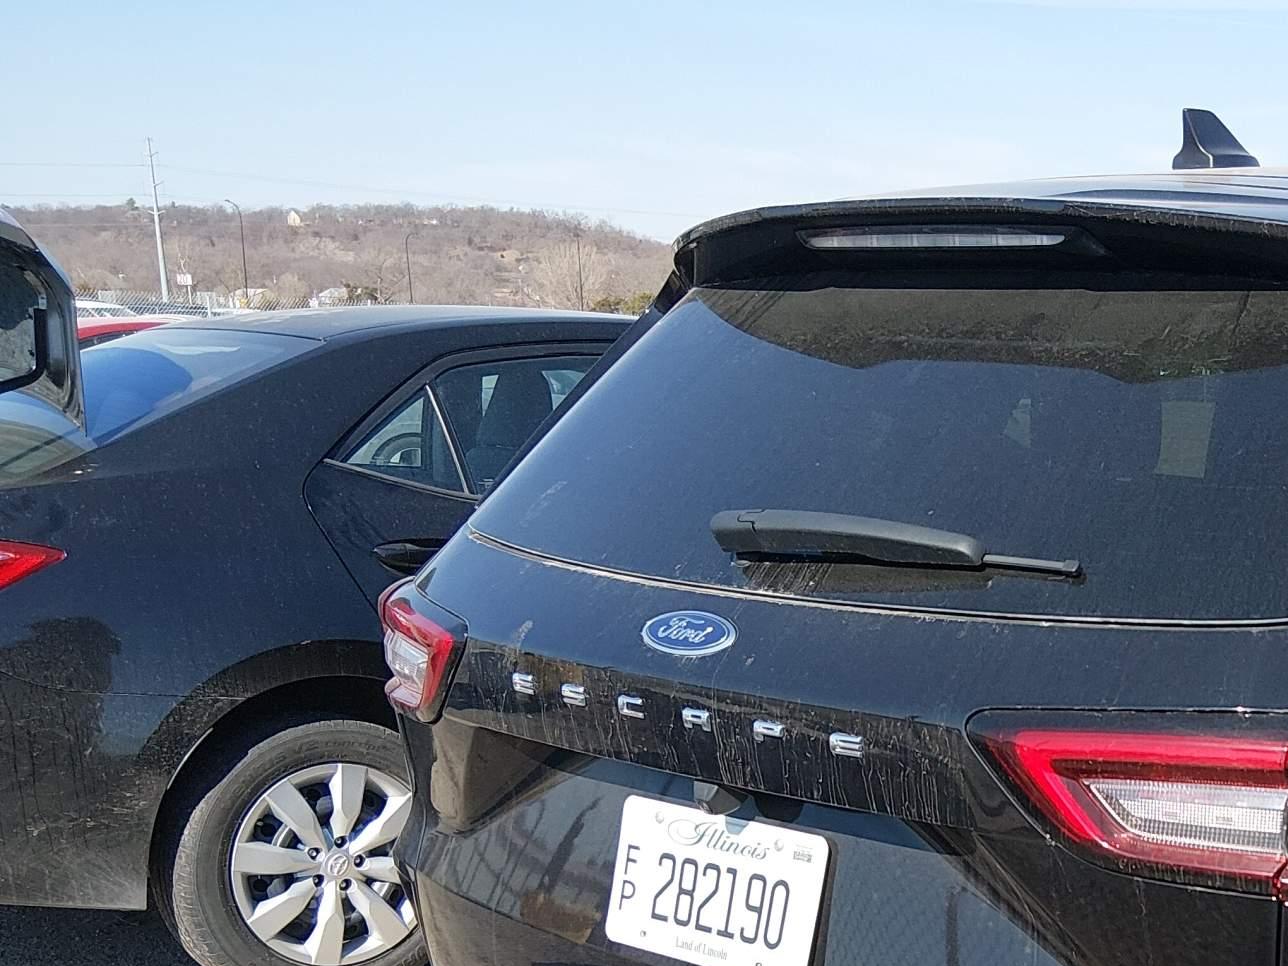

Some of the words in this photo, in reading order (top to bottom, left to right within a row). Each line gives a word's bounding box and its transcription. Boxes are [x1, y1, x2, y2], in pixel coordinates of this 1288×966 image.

[658, 616, 713, 643] Ford
[511, 671, 865, 759] ESCAPE
[667, 818, 770, 861] Illinois
[650, 852, 791, 950] 282190
[675, 936, 693, 950] Land
[694, 942, 702, 952] of
[702, 944, 728, 960] Lincoln
